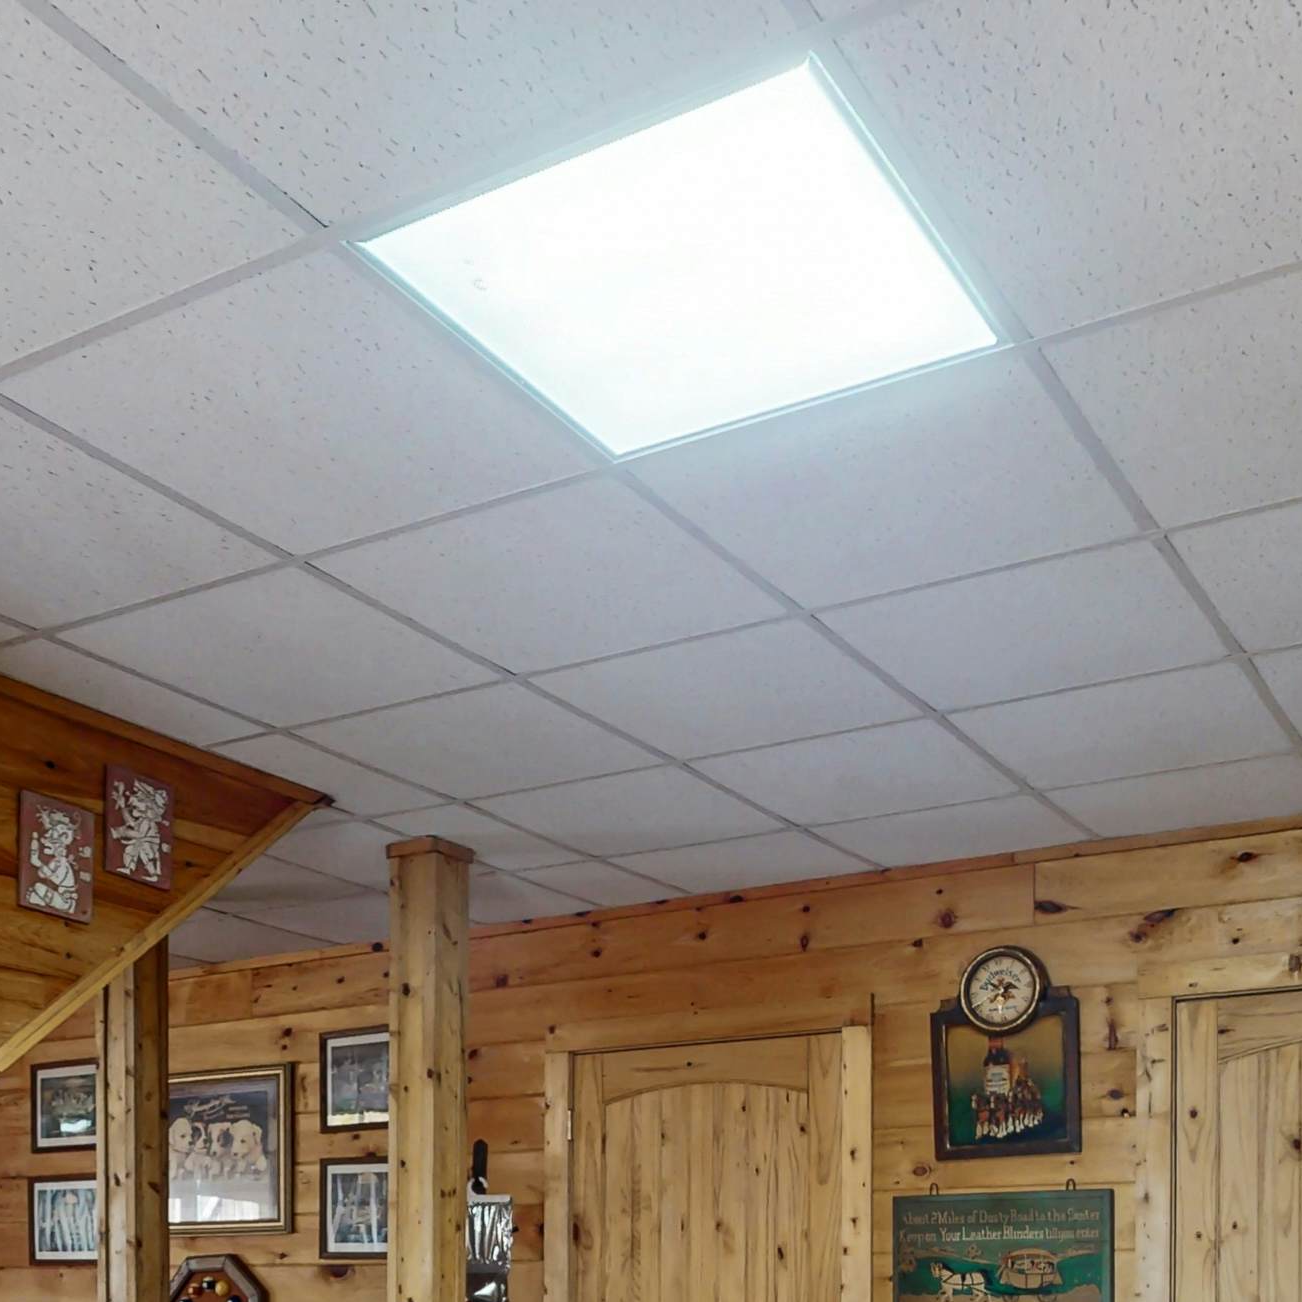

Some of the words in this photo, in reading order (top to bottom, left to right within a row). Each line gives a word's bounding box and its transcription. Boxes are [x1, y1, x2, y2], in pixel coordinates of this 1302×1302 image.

[979, 968, 1021, 991] Budweiser
[939, 1226, 961, 1242] Your
[961, 1225, 1002, 1241] Leather
[1003, 1225, 1044, 1240] Blinders
